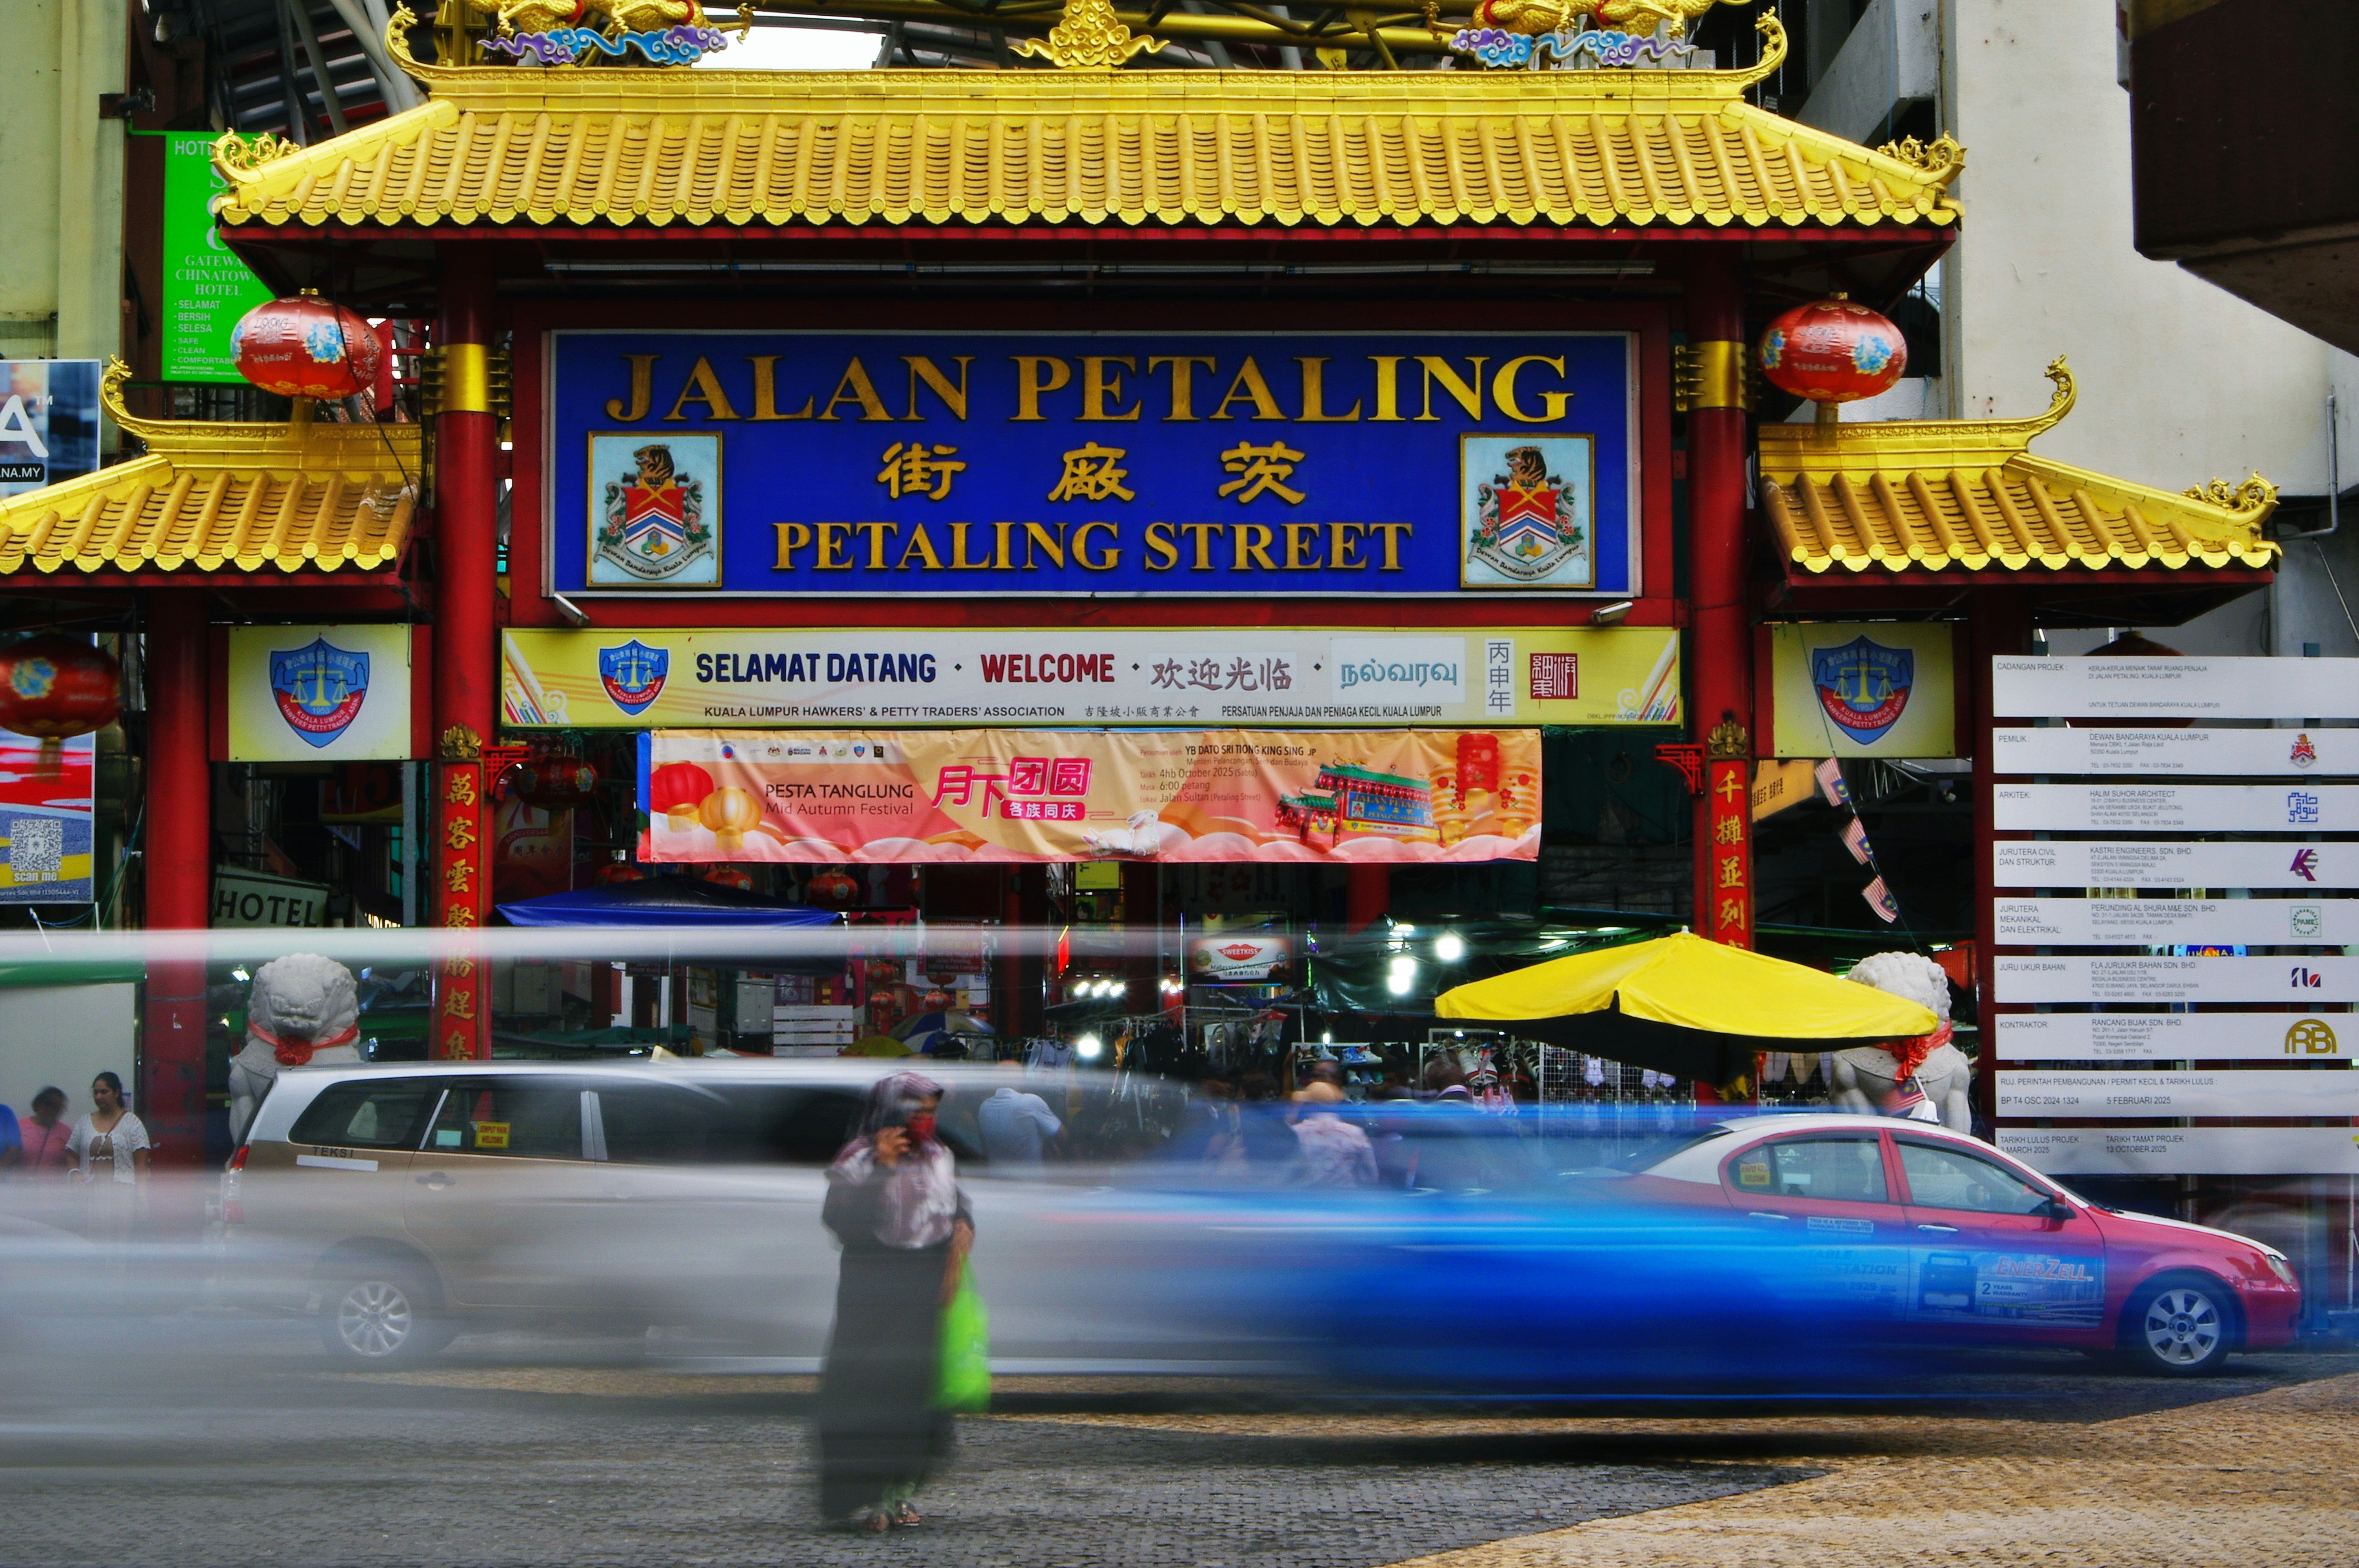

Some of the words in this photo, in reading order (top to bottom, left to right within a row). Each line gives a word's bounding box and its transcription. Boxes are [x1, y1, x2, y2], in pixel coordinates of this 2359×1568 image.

[185, 255, 247, 267] GATEWA
[195, 285, 242, 296] HOTEL
[178, 300, 220, 309] SELAMAT
[178, 313, 211, 321] BERSIH
[178, 324, 212, 332] SELESA
[606, 354, 976, 422] JALAN
[1010, 354, 1574, 423] PETALING
[772, 522, 1123, 570] PETALING
[1144, 522, 1412, 571] STREET
[696, 654, 820, 682] SELAMAT
[827, 653, 936, 682] DATANG
[980, 654, 1115, 682] WELCOME
[1151, 657, 1292, 691] 欢迎光临
[1488, 642, 1511, 713] 丙申年
[705, 708, 746, 716] KUALA
[749, 707, 799, 716] LUMPUR
[803, 707, 865, 716] HAWKERS'
[869, 707, 878, 716] &
[881, 707, 919, 716] PETTY
[922, 707, 981, 716] TRADERS'
[983, 707, 1064, 716] ASSOCIATION
[1084, 706, 1200, 718] 吉隆坡小販商業公會
[1222, 706, 1267, 716] PERSATUAN
[1269, 706, 1303, 717] PENJAJA
[1305, 707, 1321, 717] DAN
[1324, 707, 1358, 717] PENIAGA
[1359, 706, 1381, 717] KECIL
[1383, 706, 1408, 716] KUALA
[1410, 706, 1441, 716] LUMPUR
[1185, 746, 1196, 755] YB
[1199, 746, 1219, 755] DATO
[1221, 745, 1234, 754] SRI
[1236, 745, 1259, 754] TIONG
[1262, 746, 1282, 755] KING
[1284, 746, 1304, 756] SING
[1160, 769, 1176, 778] 4hb
[1178, 768, 1210, 777] October
[1213, 767, 1233, 777] 2025
[766, 784, 815, 798] PESTA
[821, 784, 913, 798] TANGLUNG
[931, 756, 1092, 819] 月下团圆
[1160, 781, 1180, 791] 6:00
[1181, 782, 1210, 791] petang
[1160, 793, 1182, 802] Jalan
[1184, 792, 1209, 801] Sultan
[766, 802, 791, 815] Mid
[797, 804, 855, 815] Autumn
[861, 803, 913, 815] Festival
[1009, 802, 1076, 818] 各族同庆
[14, 872, 39, 882] scan
[41, 872, 58, 882] me
[215, 890, 318, 927] HOTEL
[314, 1147, 353, 1158] TEKSI
[1982, 1282, 1991, 1295] 2
